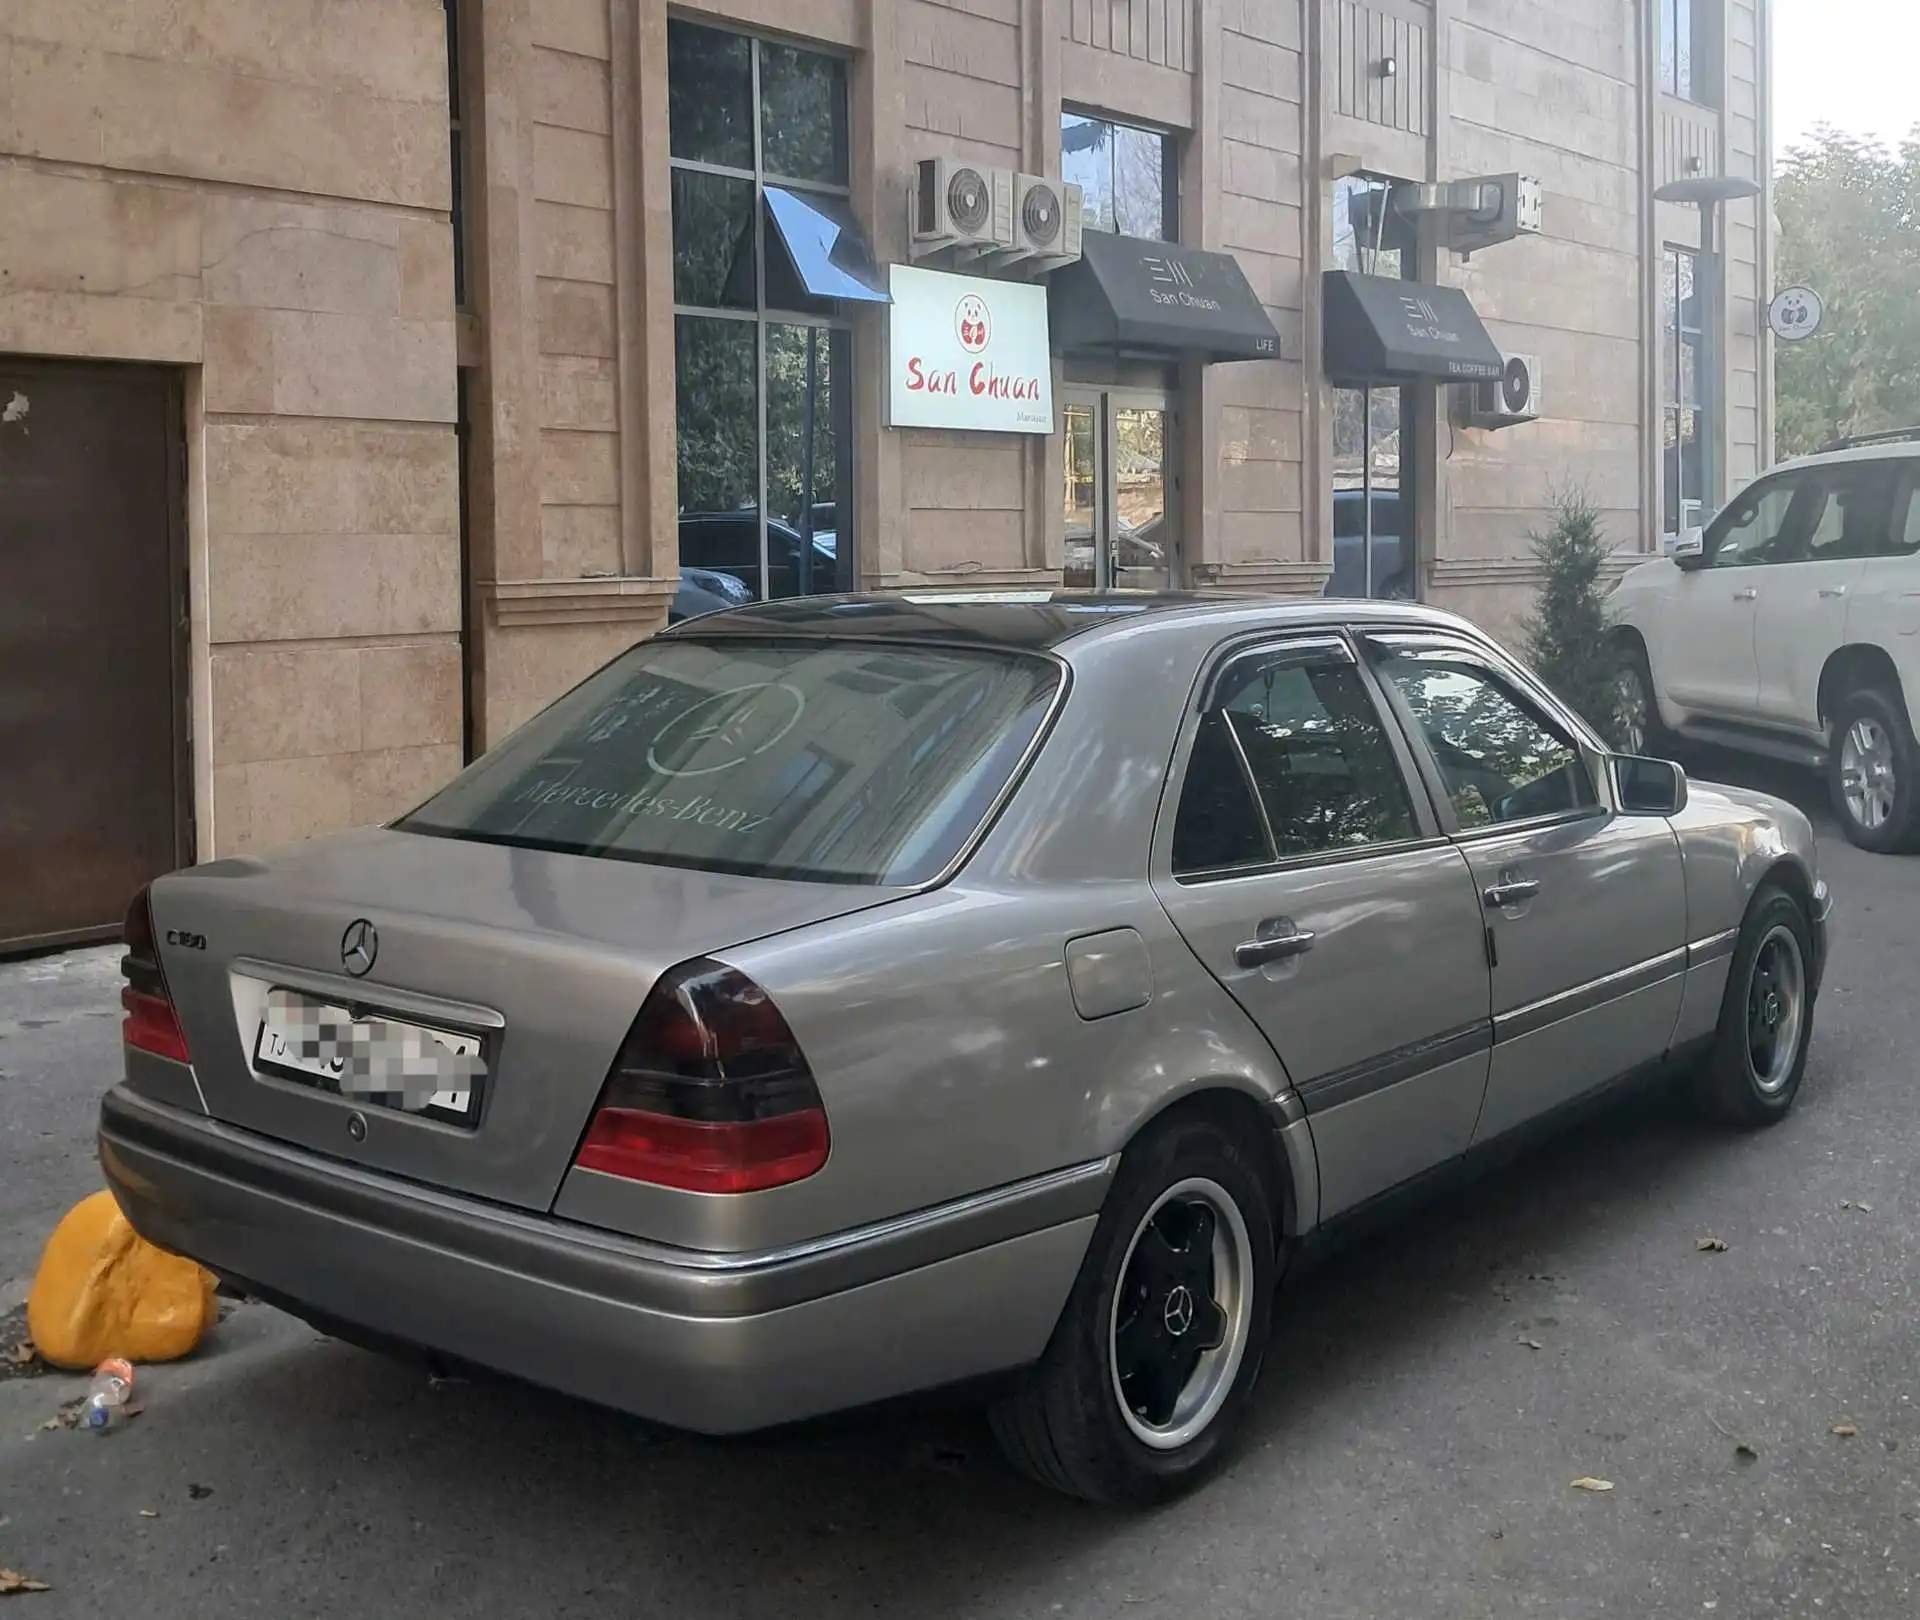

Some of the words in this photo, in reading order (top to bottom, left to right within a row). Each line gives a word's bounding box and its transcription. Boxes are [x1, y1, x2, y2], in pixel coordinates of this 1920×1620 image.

[1150, 289, 1179, 305] San
[1179, 291, 1221, 312] Chuan
[1256, 338, 1274, 352] LIFE
[906, 357, 957, 395] San
[969, 361, 1040, 401] Chuan
